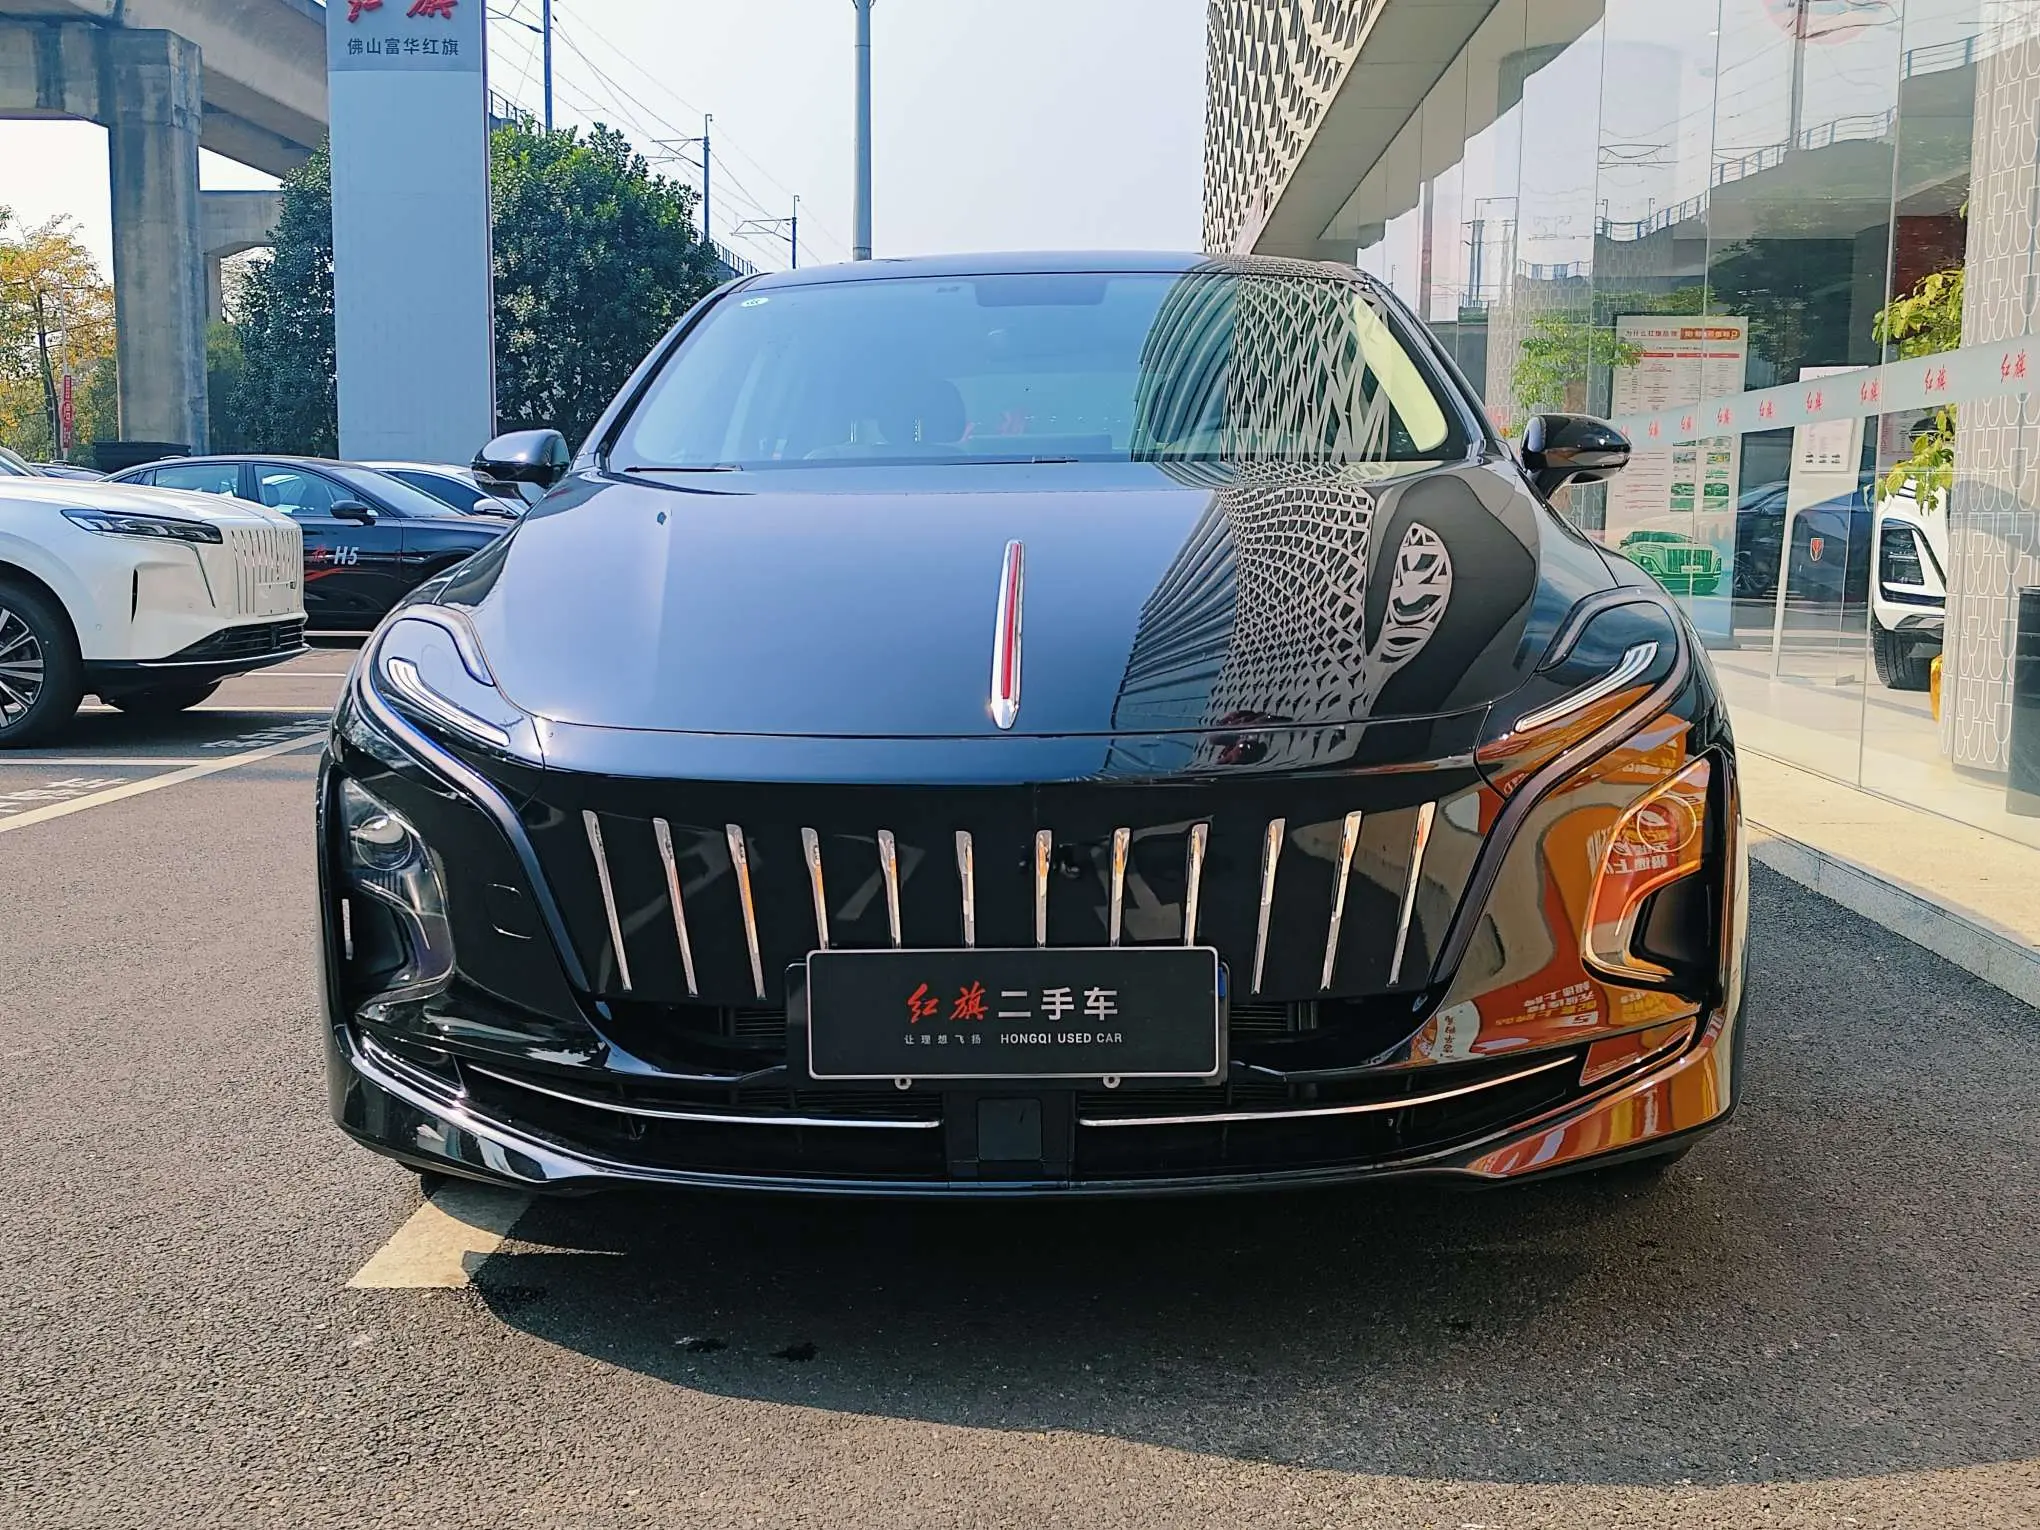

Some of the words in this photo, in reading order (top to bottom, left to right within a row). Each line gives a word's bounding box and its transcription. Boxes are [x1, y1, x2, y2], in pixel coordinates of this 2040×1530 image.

[347, 37, 459, 56] 佛山富华红旗
[2001, 348, 2026, 383] 红旗
[1924, 364, 1947, 395] 红旗
[334, 546, 360, 565] H5
[904, 1033, 982, 1045] 让理想飞扬
[1001, 1032, 1052, 1045] HONGQI
[1057, 1032, 1092, 1045] USED
[1096, 1033, 1123, 1044] CAR
